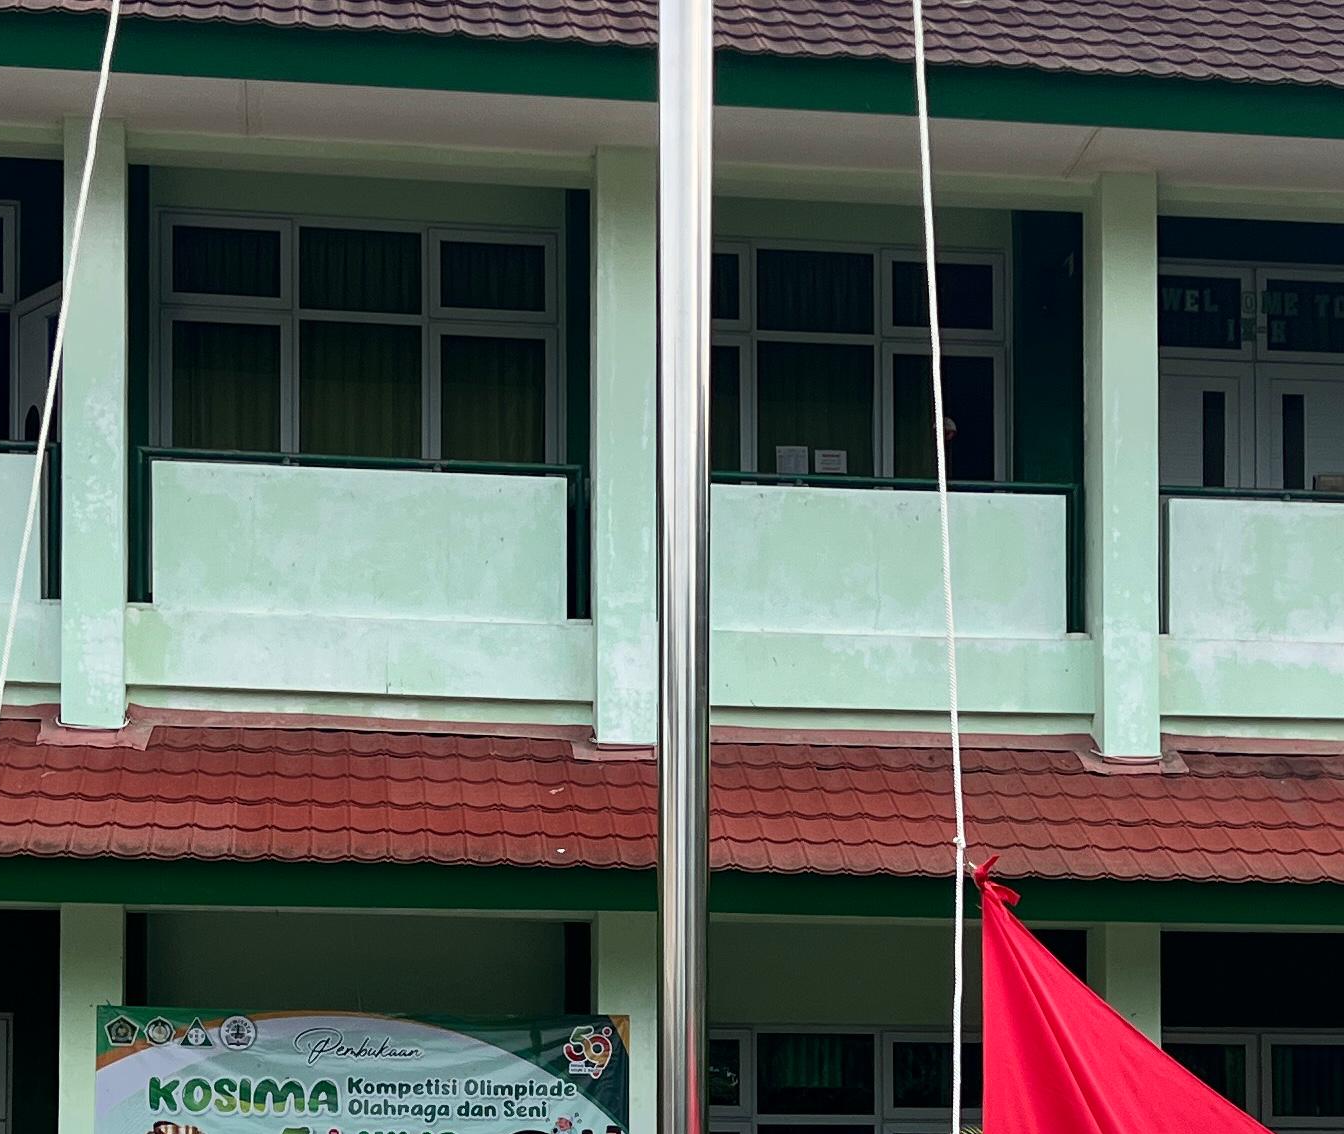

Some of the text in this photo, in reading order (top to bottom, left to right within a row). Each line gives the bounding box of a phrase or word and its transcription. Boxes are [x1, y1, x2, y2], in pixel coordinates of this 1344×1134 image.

[294, 1027, 421, 1064] Pembukaan
[148, 1076, 576, 1113] KOSIMA Kompetisi Olimpiade
[347, 1099, 547, 1122] Olahraga dan Seni
